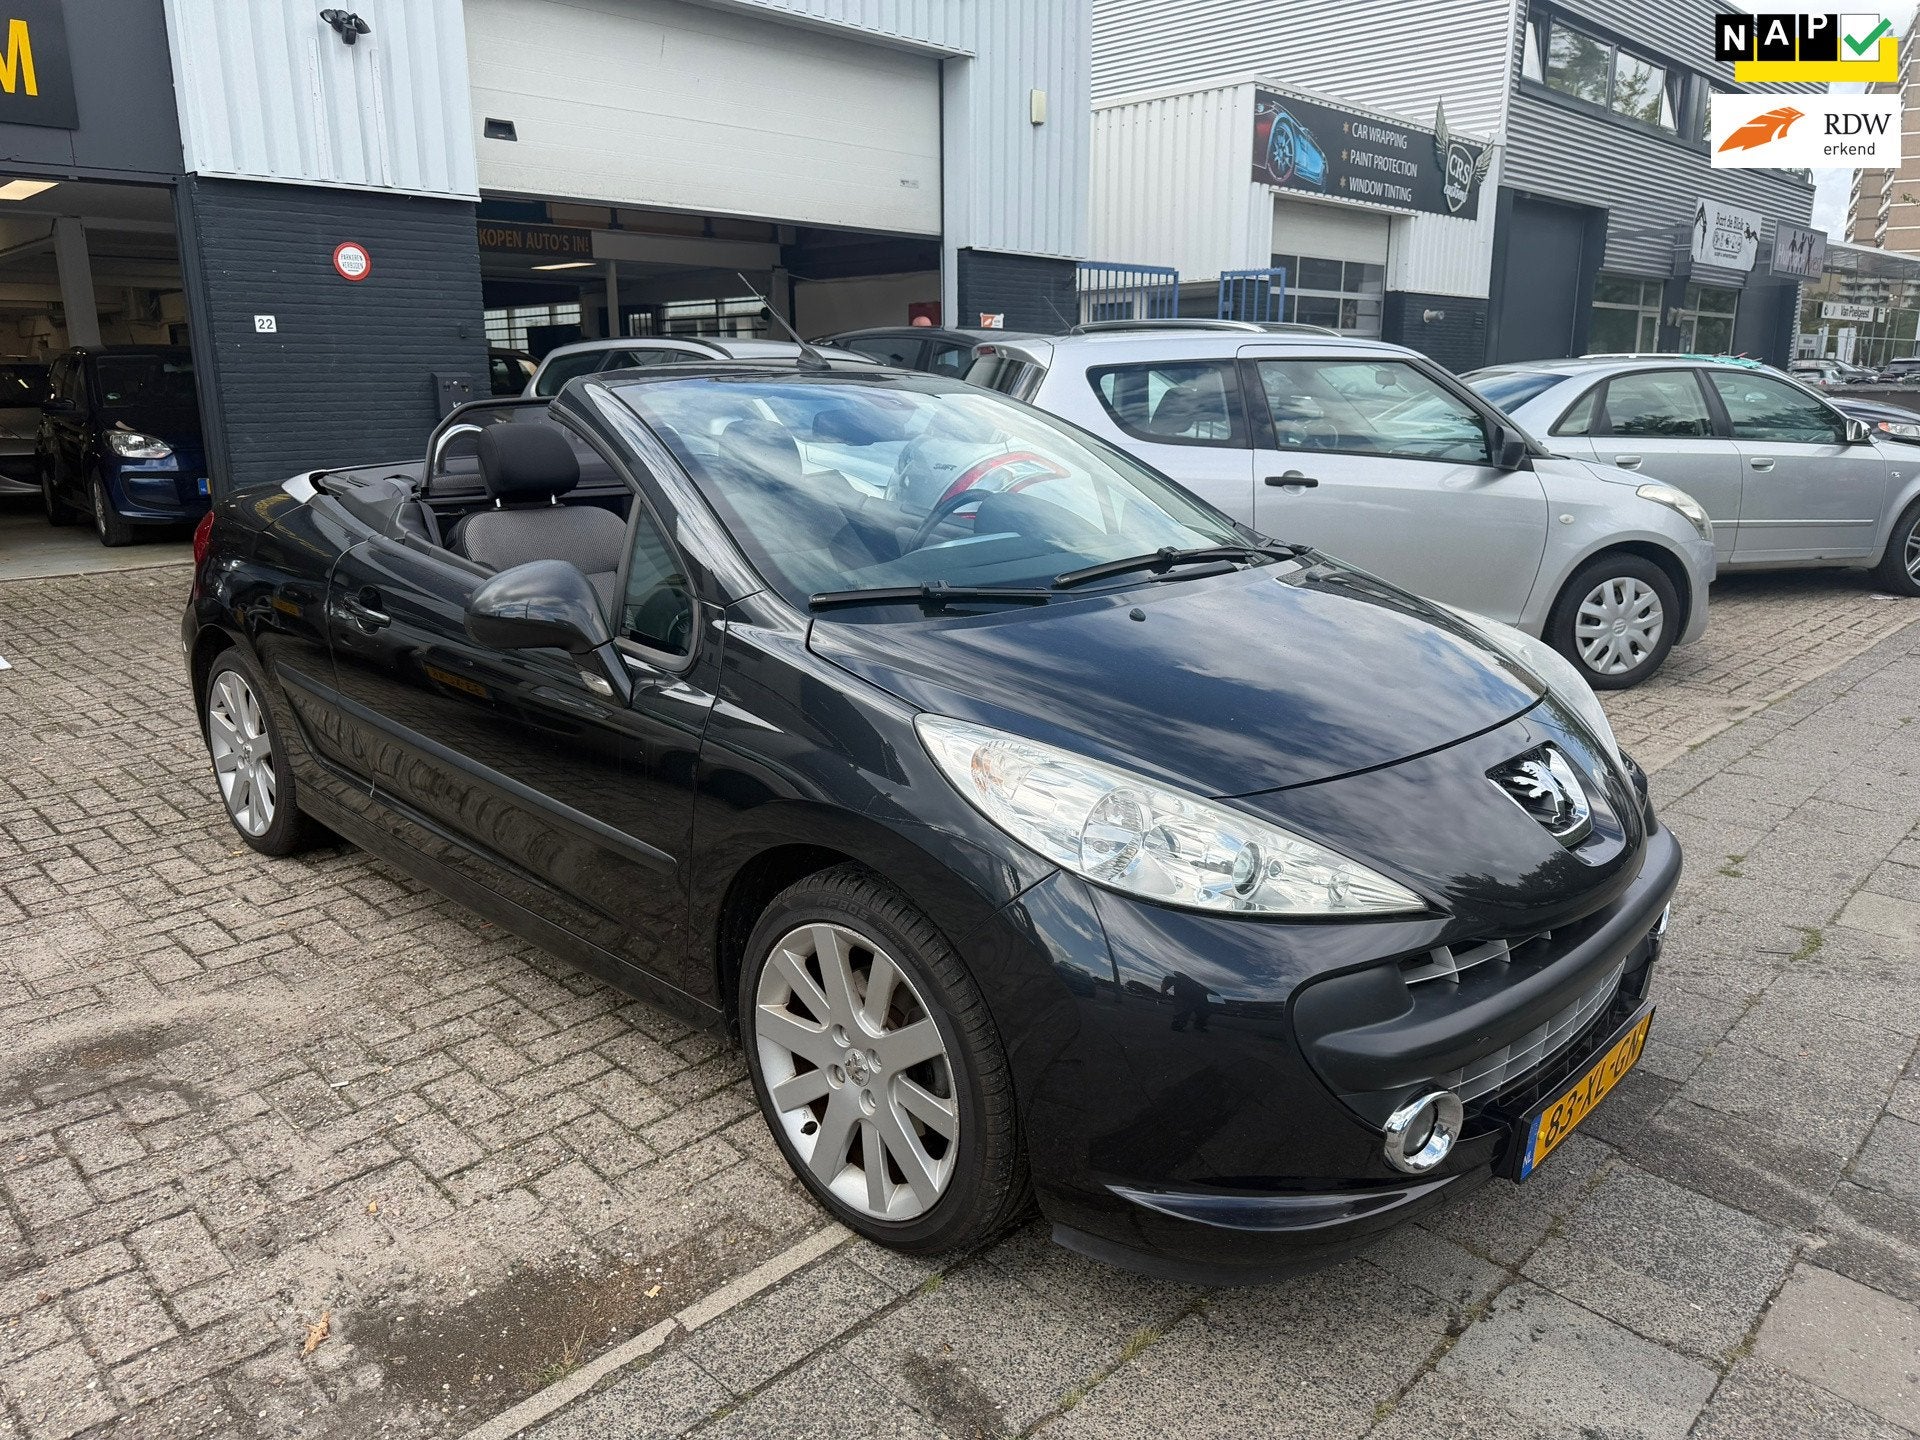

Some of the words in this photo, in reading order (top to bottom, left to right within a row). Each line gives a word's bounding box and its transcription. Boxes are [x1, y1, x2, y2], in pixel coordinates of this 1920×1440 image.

[1352, 122, 1368, 140] CAR
[1369, 126, 1407, 149] WRAPPING
[1350, 149, 1373, 168] PAINT
[1373, 154, 1418, 178] PROTECTION
[1450, 154, 1471, 185] CRS
[1349, 176, 1383, 197] WINDOW
[1384, 183, 1412, 202] TINTING
[479, 228, 522, 248] KOPEN
[526, 231, 570, 251] AUTO'S
[572, 236, 589, 252] IN!
[258, 318, 274, 330] 22
[1545, 1021, 1646, 1149] 83-XL-GN
